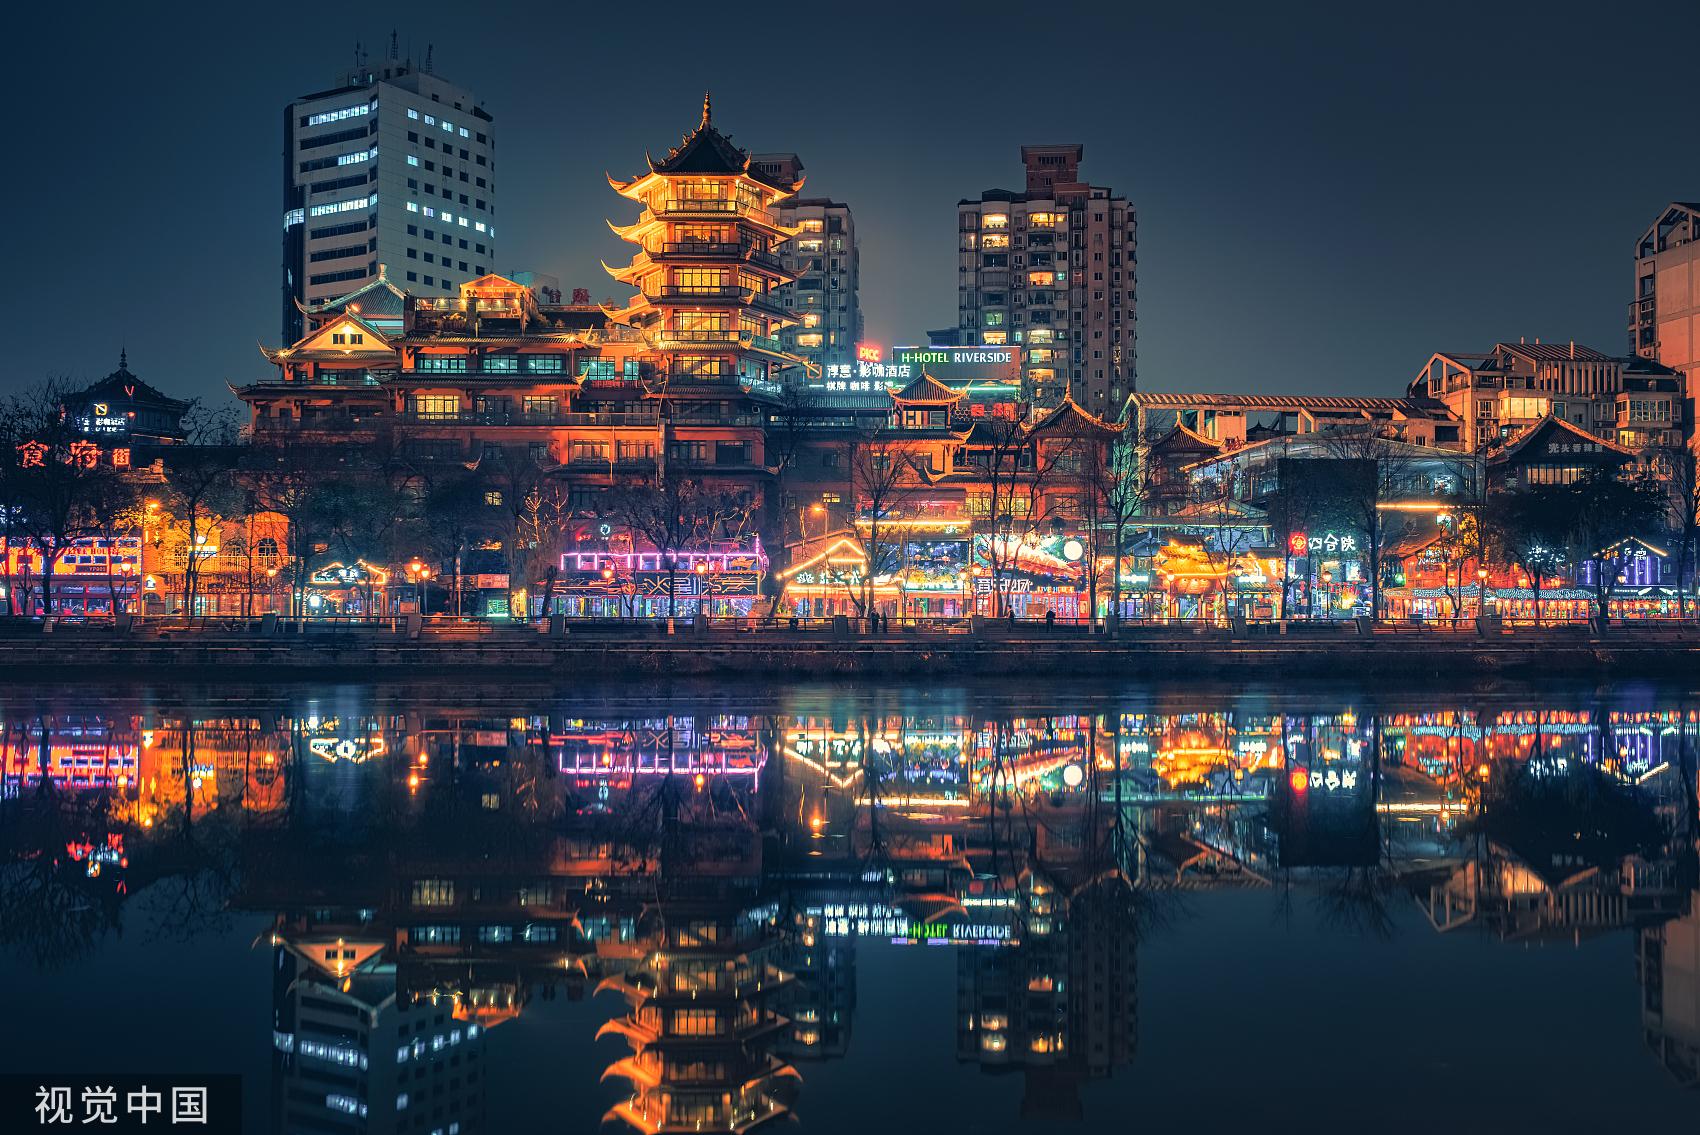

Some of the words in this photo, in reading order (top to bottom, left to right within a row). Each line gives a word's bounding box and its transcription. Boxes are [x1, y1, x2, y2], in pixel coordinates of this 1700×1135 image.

[859, 347, 880, 361] PICC
[902, 353, 948, 363] H-HOTEL
[954, 353, 1011, 363] RIVERSIDE
